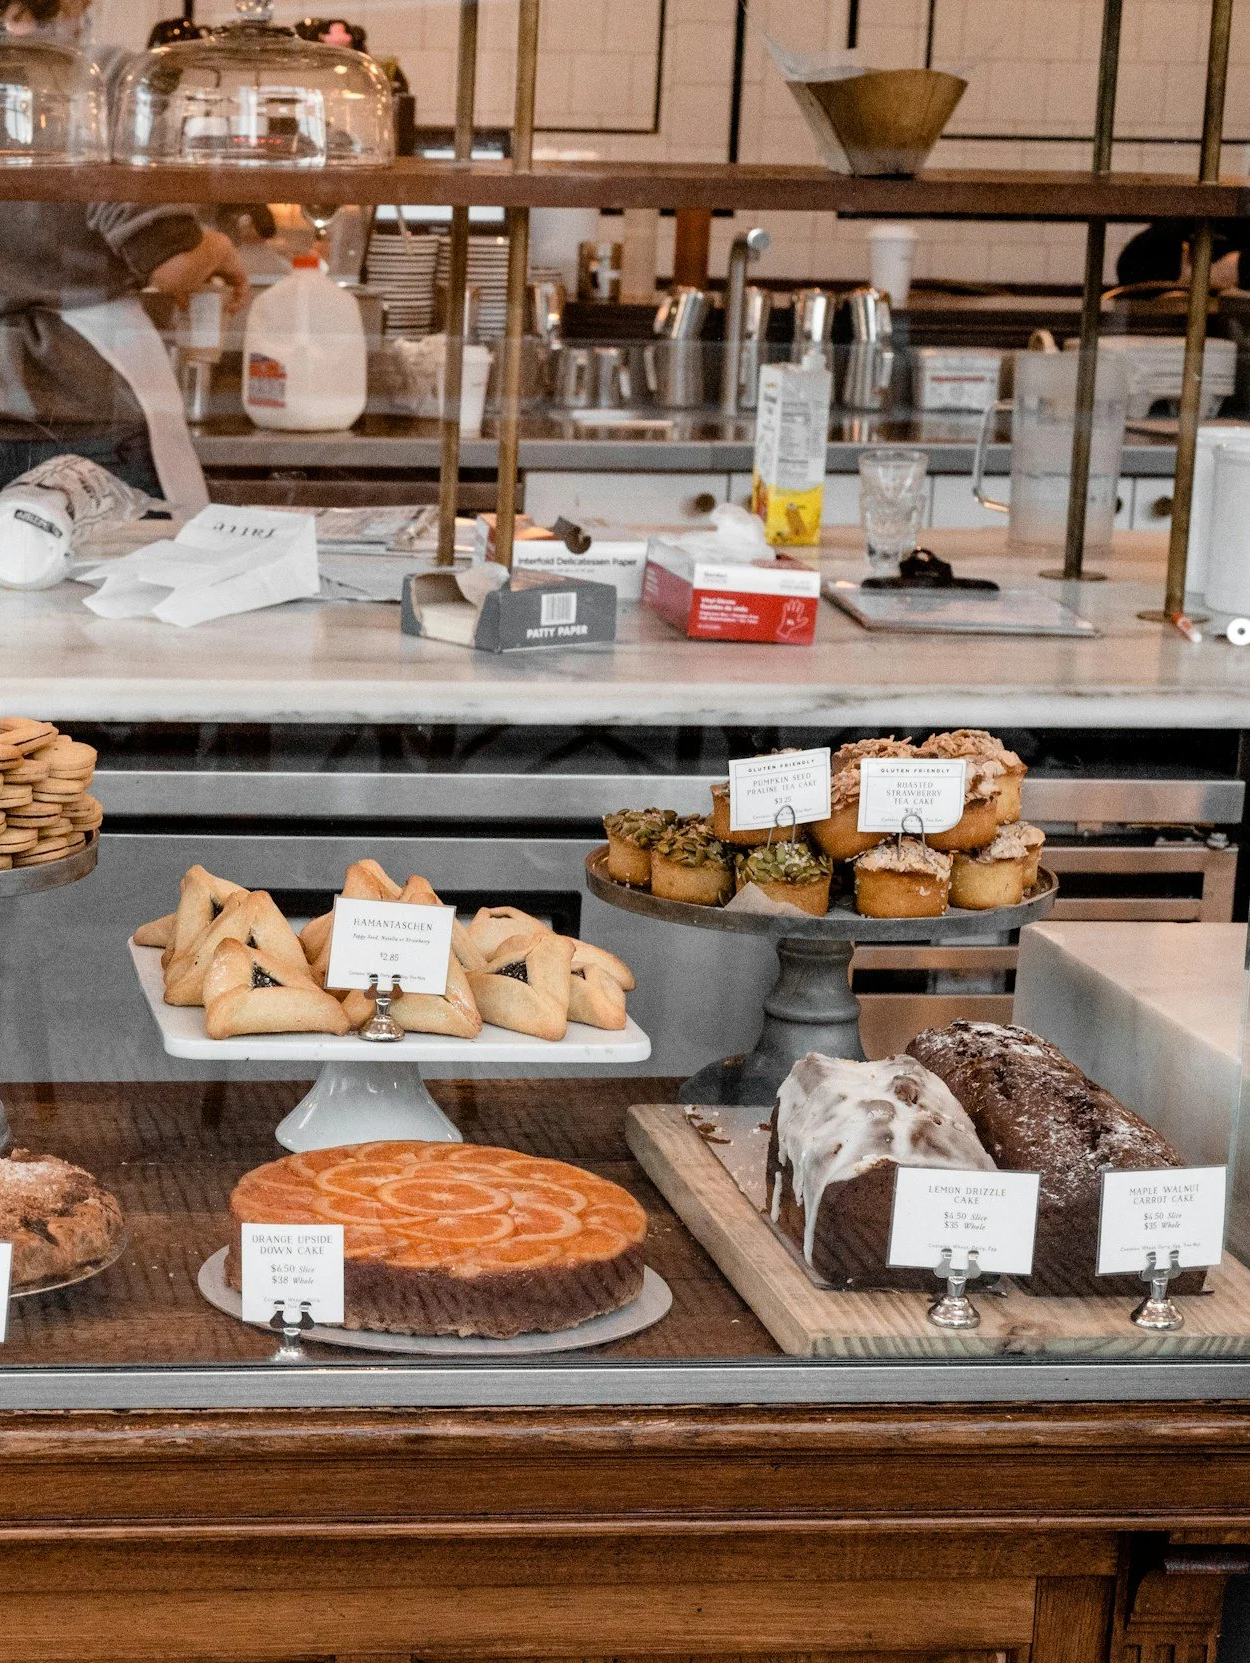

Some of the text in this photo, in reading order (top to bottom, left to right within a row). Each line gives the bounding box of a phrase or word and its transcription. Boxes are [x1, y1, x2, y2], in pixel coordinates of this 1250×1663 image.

[557, 558, 611, 566] Delicatessen
[612, 558, 637, 567] Paper
[526, 625, 588, 639] PATTY PAPER
[780, 759, 815, 768] FRIENDLY
[753, 776, 789, 786] PUMPKIN
[747, 786, 777, 796] PRALINE
[798, 780, 816, 788] CAKE
[353, 918, 433, 931] HAMANTASCHEN
[928, 1185, 1006, 1196] LEMON DRIZZLE
[1130, 1184, 1200, 1196] MAPLE WALNUT
[953, 1196, 979, 1204] CAKE
[1133, 1194, 1194, 1205] CARROT CAKE
[970, 1213, 988, 1221] Slice
[944, 1221, 958, 1229] $35
[1144, 1222, 1157, 1230] $35
[252, 1235, 333, 1244] ORANGE UPSIDE
[260, 1246, 324, 1255] DOWN CAKE
[272, 1275, 289, 1284] $38
